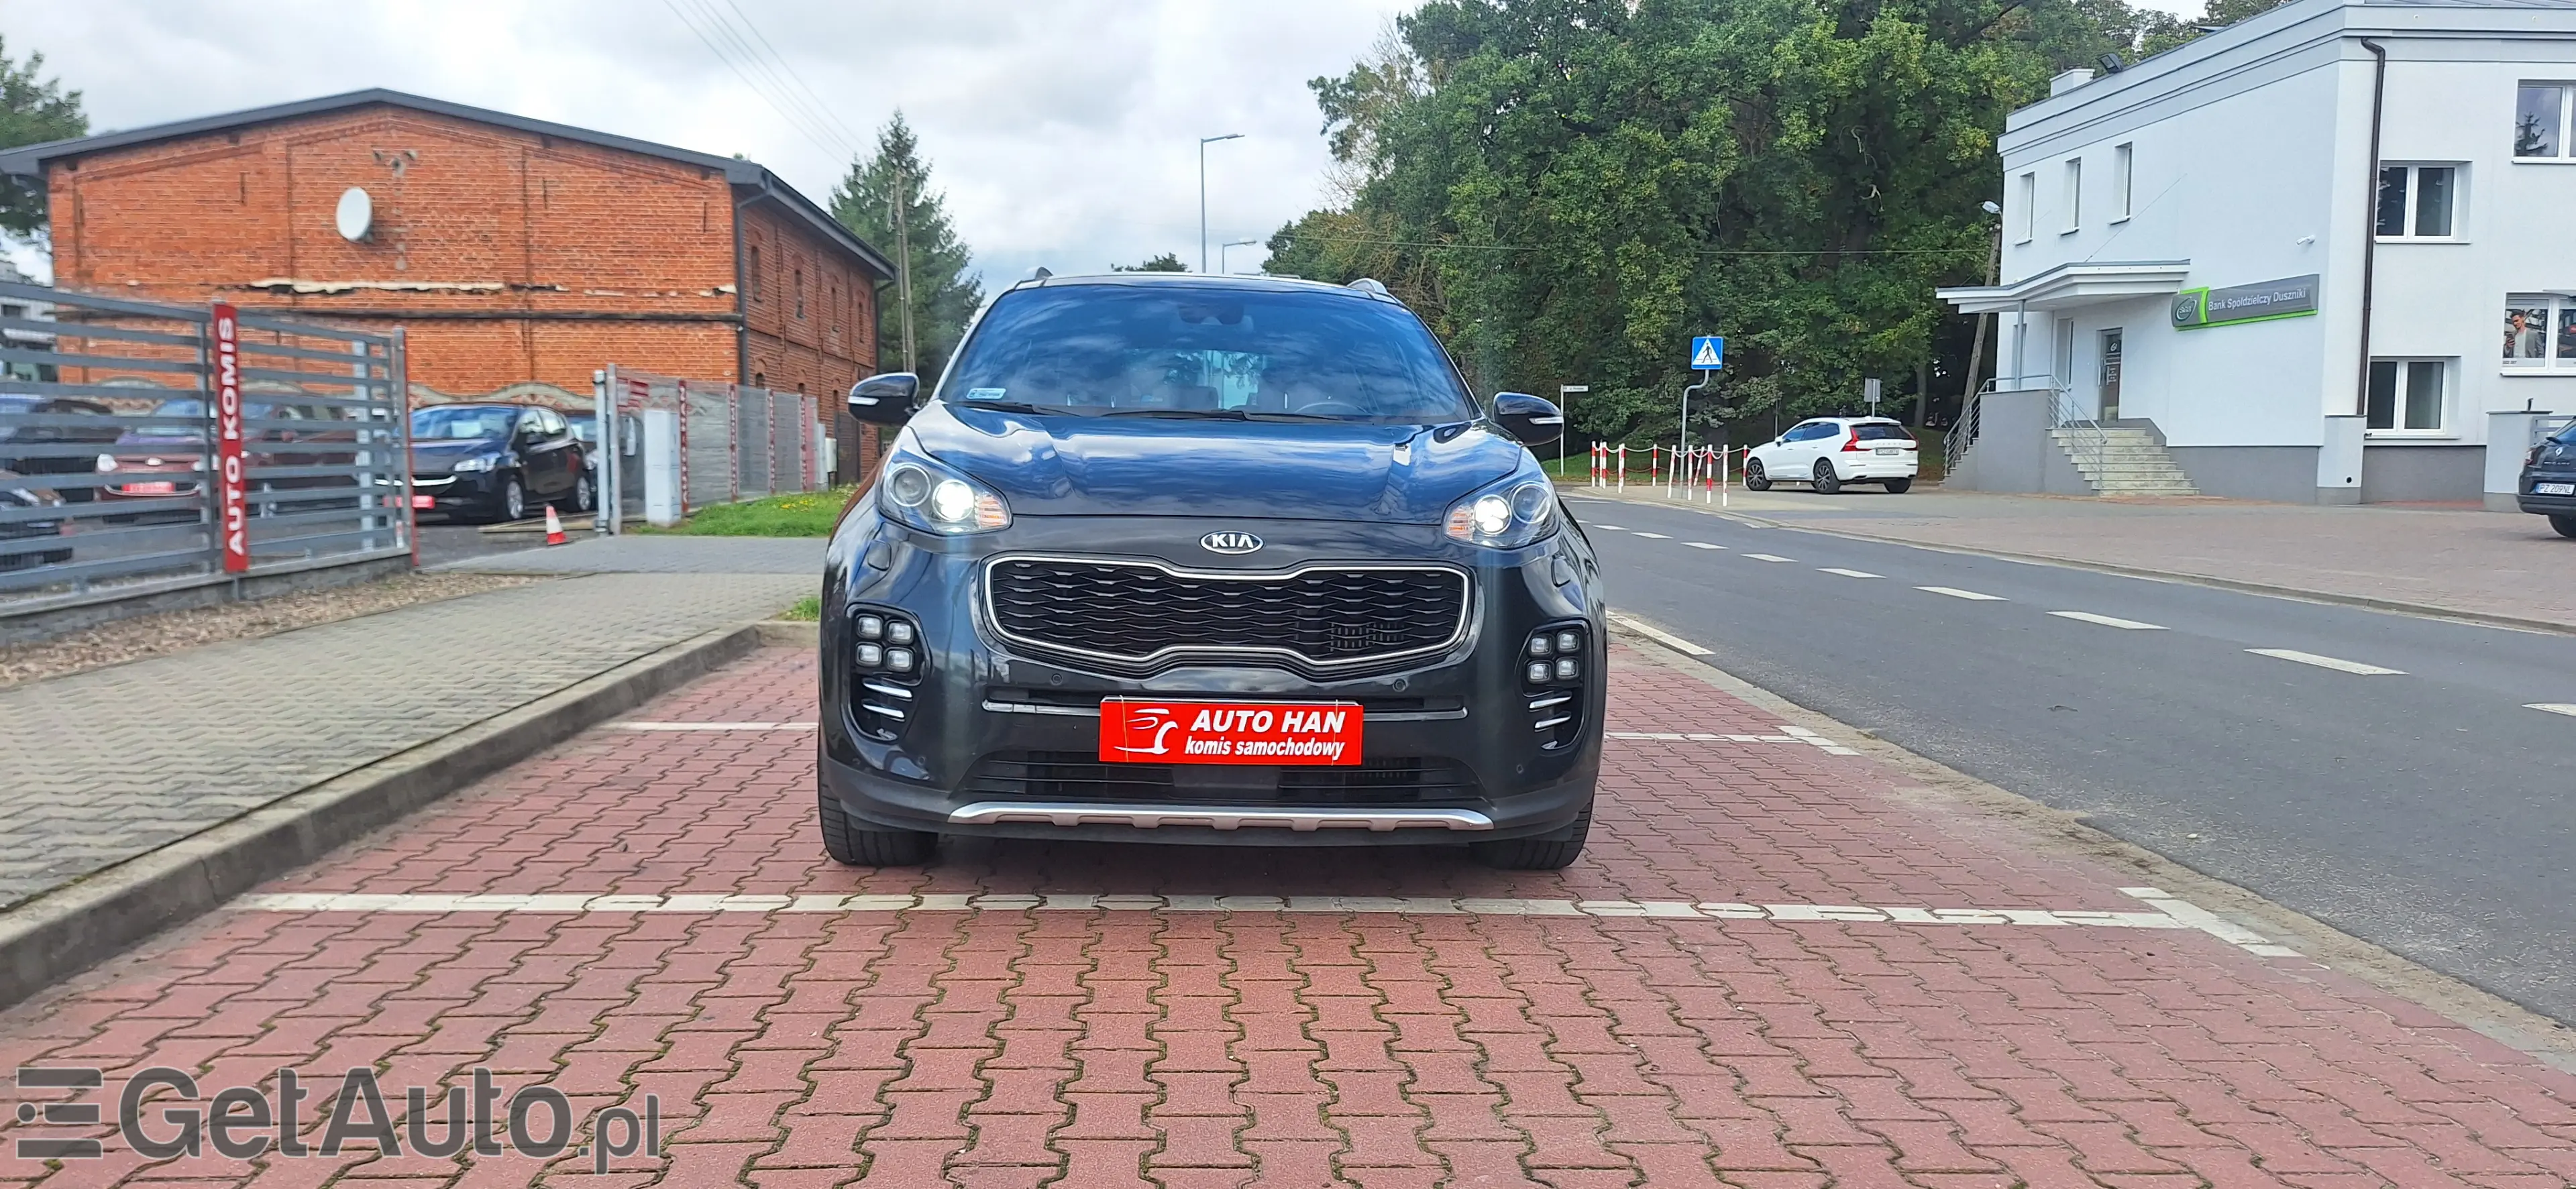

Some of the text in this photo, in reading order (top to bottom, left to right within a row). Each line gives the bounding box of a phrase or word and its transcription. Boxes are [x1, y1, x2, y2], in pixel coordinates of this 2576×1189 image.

[2208, 288, 2306, 310] Bank Spółdzielczy Duszniki
[218, 317, 246, 557] AUTO KOMIS
[1212, 533, 1254, 549] KIA
[1190, 710, 1347, 734] AUTO HAN
[1185, 735, 1345, 761] komis samochodowy
